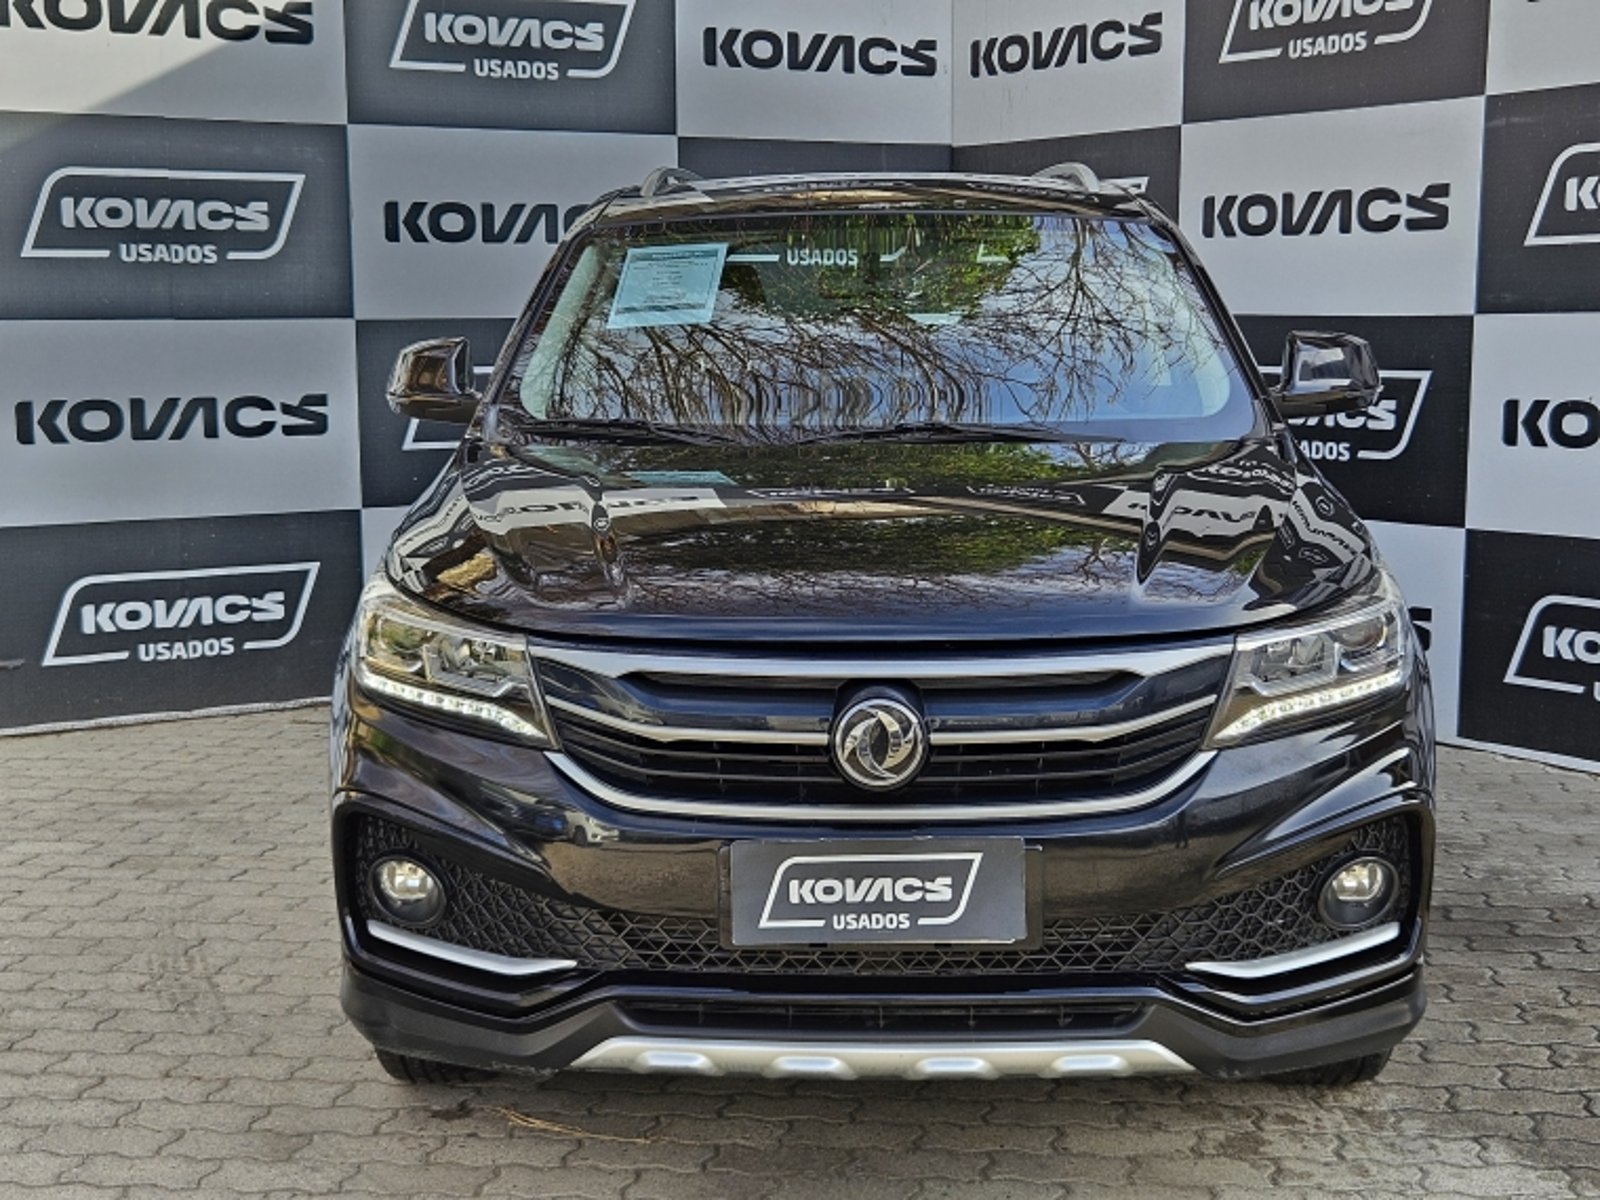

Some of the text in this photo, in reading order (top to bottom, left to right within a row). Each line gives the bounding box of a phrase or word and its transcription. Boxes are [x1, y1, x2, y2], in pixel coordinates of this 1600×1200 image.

[424, 12, 605, 51] KOVACS
[970, 12, 1163, 78] KOVACS
[1288, 31, 1367, 59] USADOS
[473, 58, 560, 80] USADOS
[703, 27, 937, 77] KOVACS
[60, 197, 270, 231] KOVACS
[384, 200, 593, 244] KOVA
[1202, 183, 1451, 238] KOVACS
[120, 243, 218, 264] USADOS
[786, 248, 858, 267] USADOS
[15, 394, 329, 445] KOVACS
[80, 591, 285, 634] KOVACS
[138, 638, 234, 661] USADOS
[788, 877, 952, 904] KOVACS
[832, 913, 910, 930] USADOS
